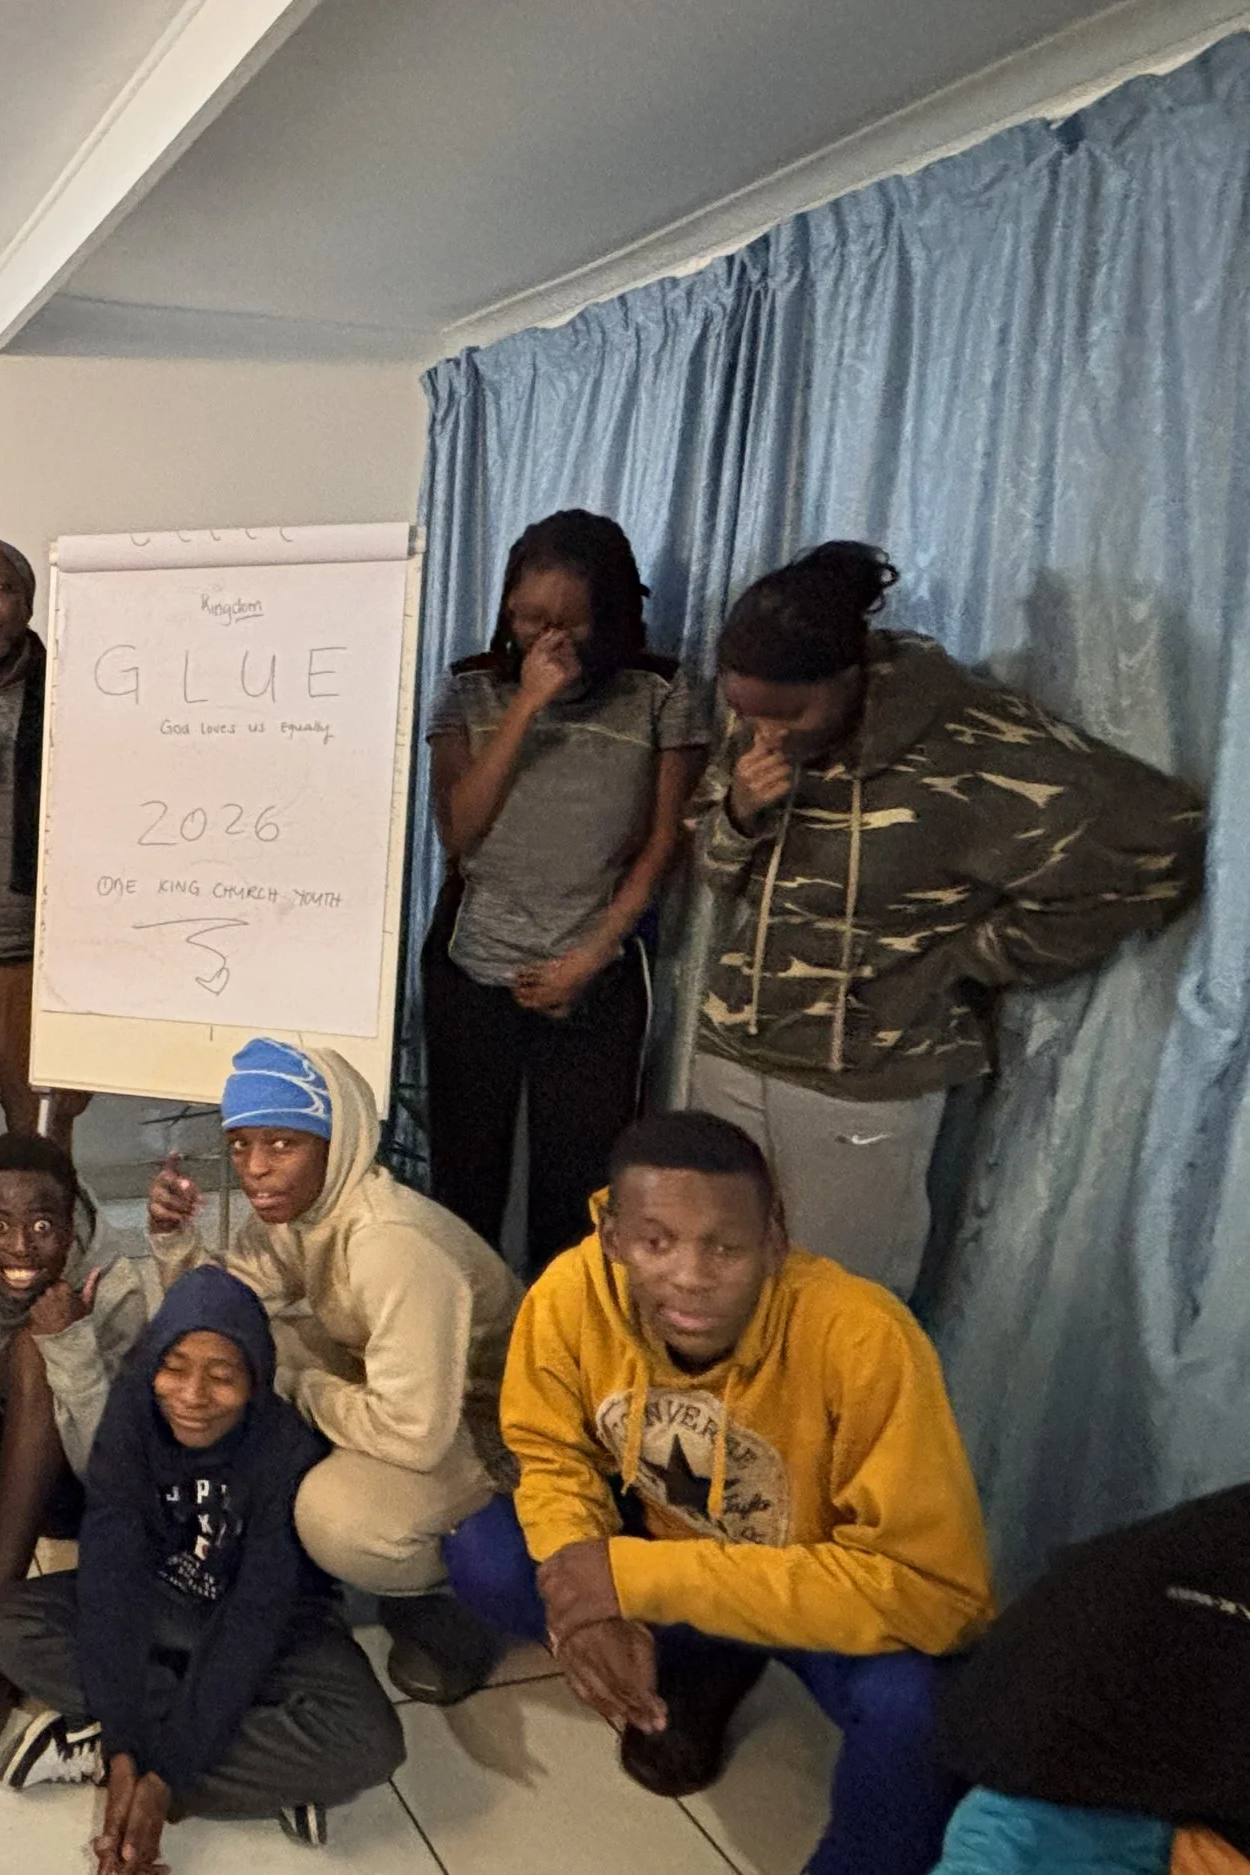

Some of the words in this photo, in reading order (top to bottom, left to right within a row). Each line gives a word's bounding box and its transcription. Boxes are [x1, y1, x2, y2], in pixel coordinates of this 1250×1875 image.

[200, 592, 263, 628] Kingdom
[159, 719, 190, 735] God
[200, 722, 237, 735] loves
[248, 722, 266, 734] us
[137, 799, 280, 846] 2026
[157, 880, 201, 896] KING
[211, 882, 279, 903] CHURCH
[293, 888, 343, 908] YOUTH
